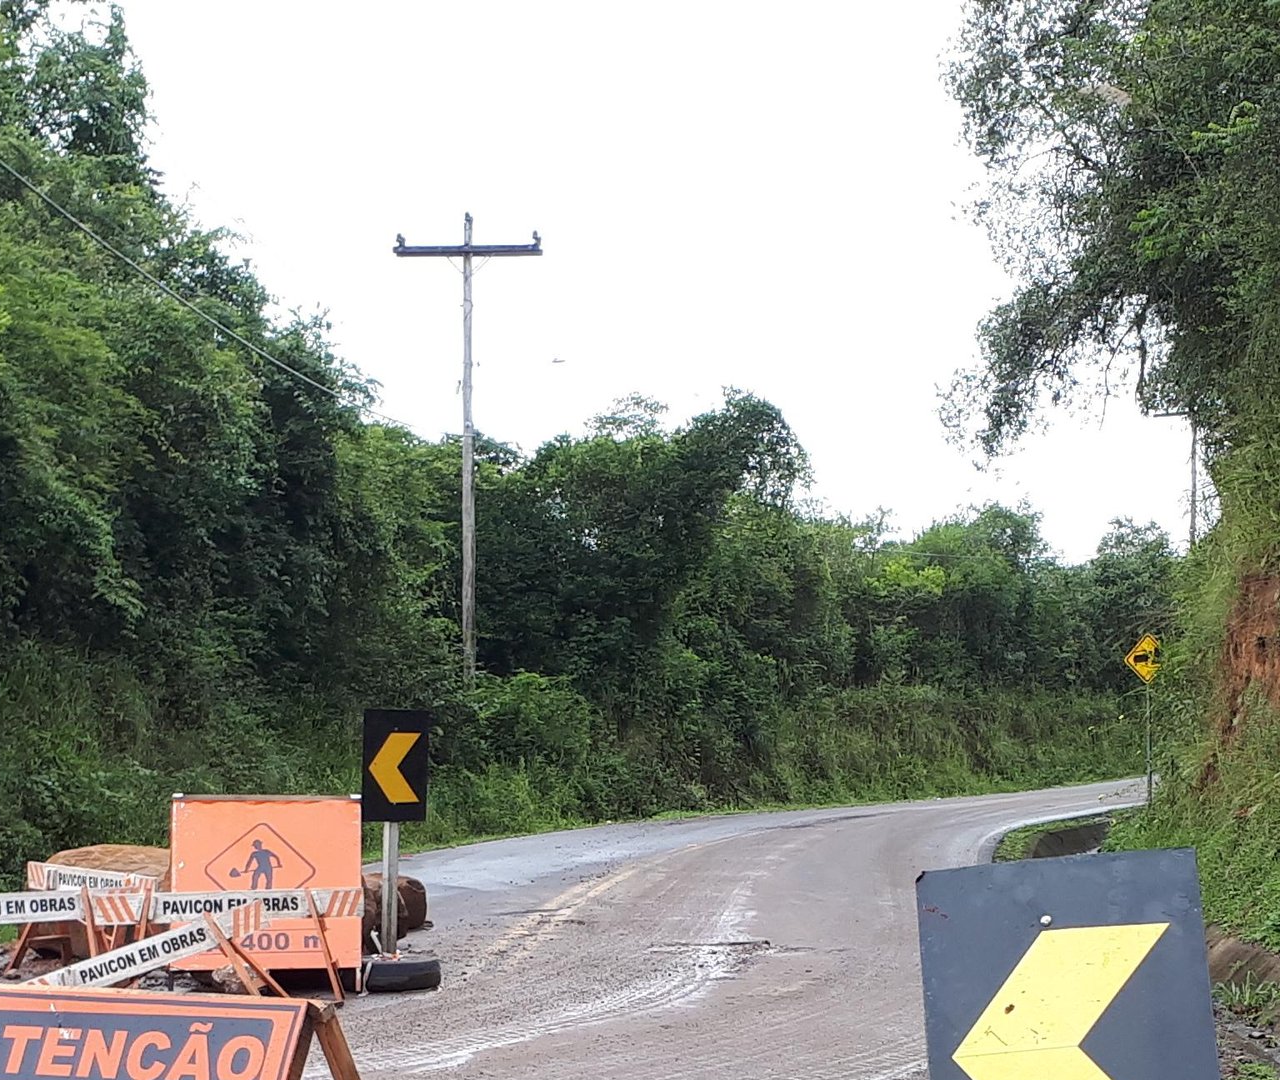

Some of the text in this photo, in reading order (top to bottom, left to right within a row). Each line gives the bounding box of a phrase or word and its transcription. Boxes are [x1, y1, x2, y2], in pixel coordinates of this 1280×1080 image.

[89, 876, 98, 888] EM
[6, 900, 25, 914] EM
[29, 897, 76, 912] OBRAS
[162, 899, 223, 915] PAVICON
[253, 896, 299, 912] BRAS
[240, 932, 290, 951] 400
[79, 927, 207, 984] PAVICON EM OBRAS
